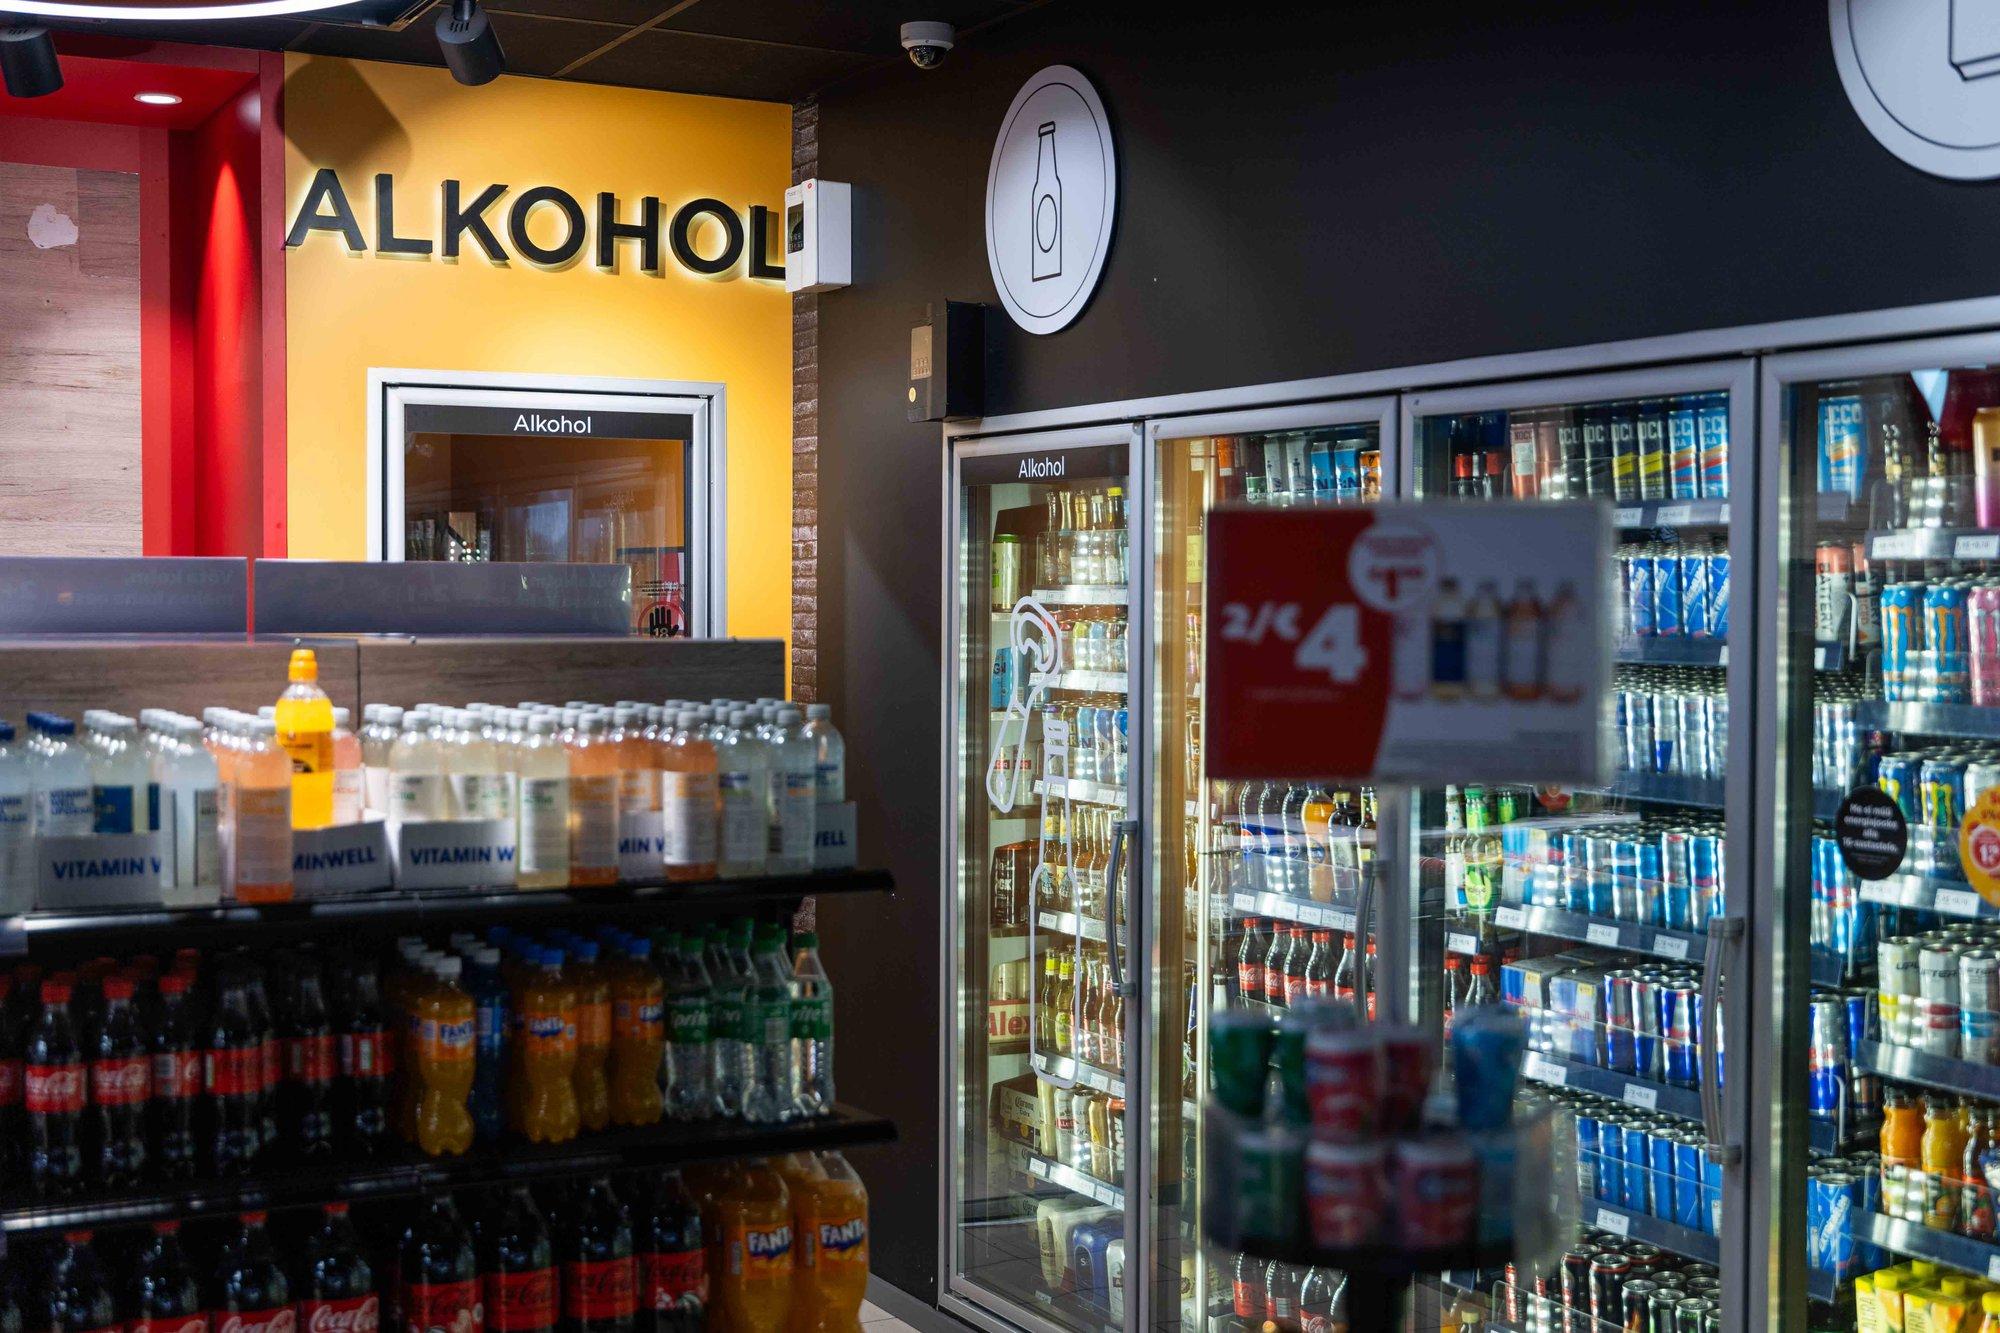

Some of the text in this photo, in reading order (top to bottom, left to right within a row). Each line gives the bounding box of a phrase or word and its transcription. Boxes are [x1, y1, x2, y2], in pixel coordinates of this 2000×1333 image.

[284, 169, 786, 280] ALKOHOL
[513, 414, 592, 434] Alkohol
[1018, 456, 1065, 478] Alkohol
[1295, 604, 1368, 684] 4
[411, 846, 490, 866] VITAMIN
[53, 857, 145, 880] VITAMIN
